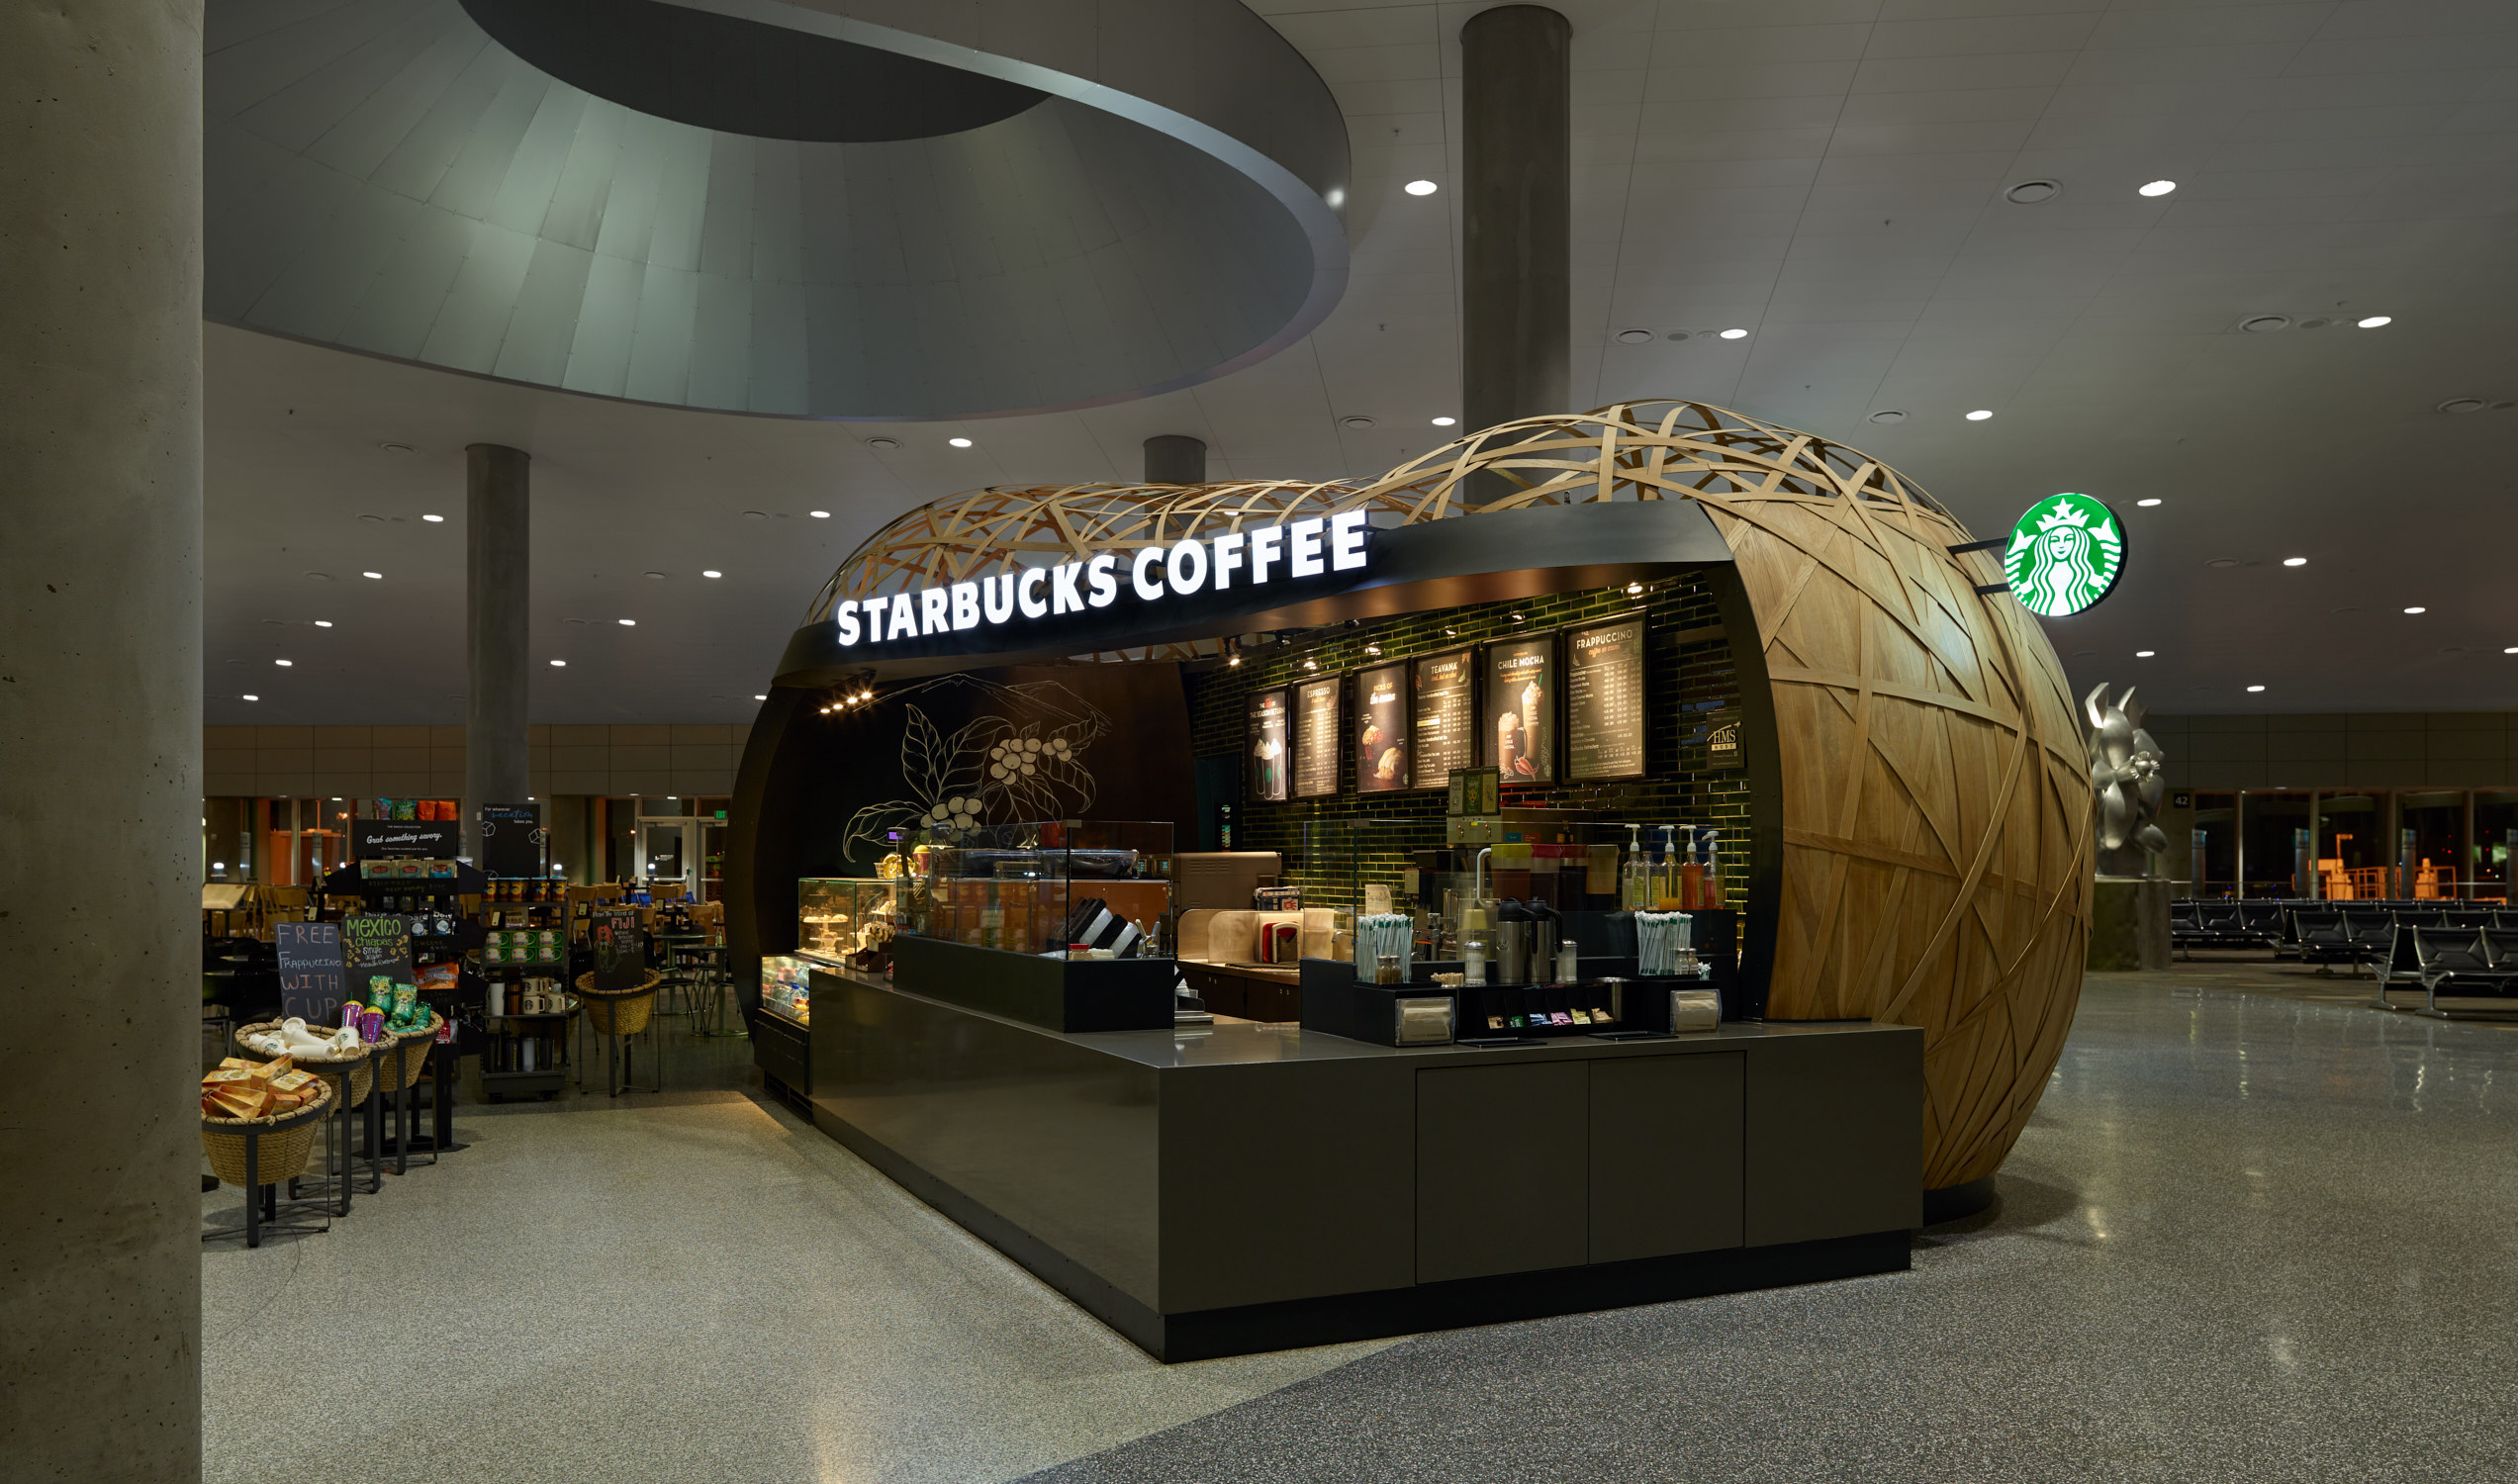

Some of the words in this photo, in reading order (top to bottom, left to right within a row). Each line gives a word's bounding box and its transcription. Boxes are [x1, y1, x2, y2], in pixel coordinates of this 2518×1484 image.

[837, 555, 1117, 646] STARBUCKS
[1132, 510, 1369, 601] COFFEE
[1576, 629, 1632, 649] FRAPPUCCINO
[1498, 659, 1518, 670] CHILE
[1519, 655, 1544, 667] MOCHA
[1307, 687, 1331, 698] ESPRESSO
[1713, 729, 1736, 744] HMS
[2175, 795, 2190, 806] 42
[491, 808, 533, 820] vacation
[366, 834, 385, 845] Grab
[385, 832, 419, 844] something
[419, 832, 443, 842] savory.
[346, 916, 402, 938] Mexico
[610, 916, 635, 929] FIJI
[278, 924, 334, 945] FREE
[280, 973, 338, 991] WITH
[285, 996, 337, 1022] CUP
